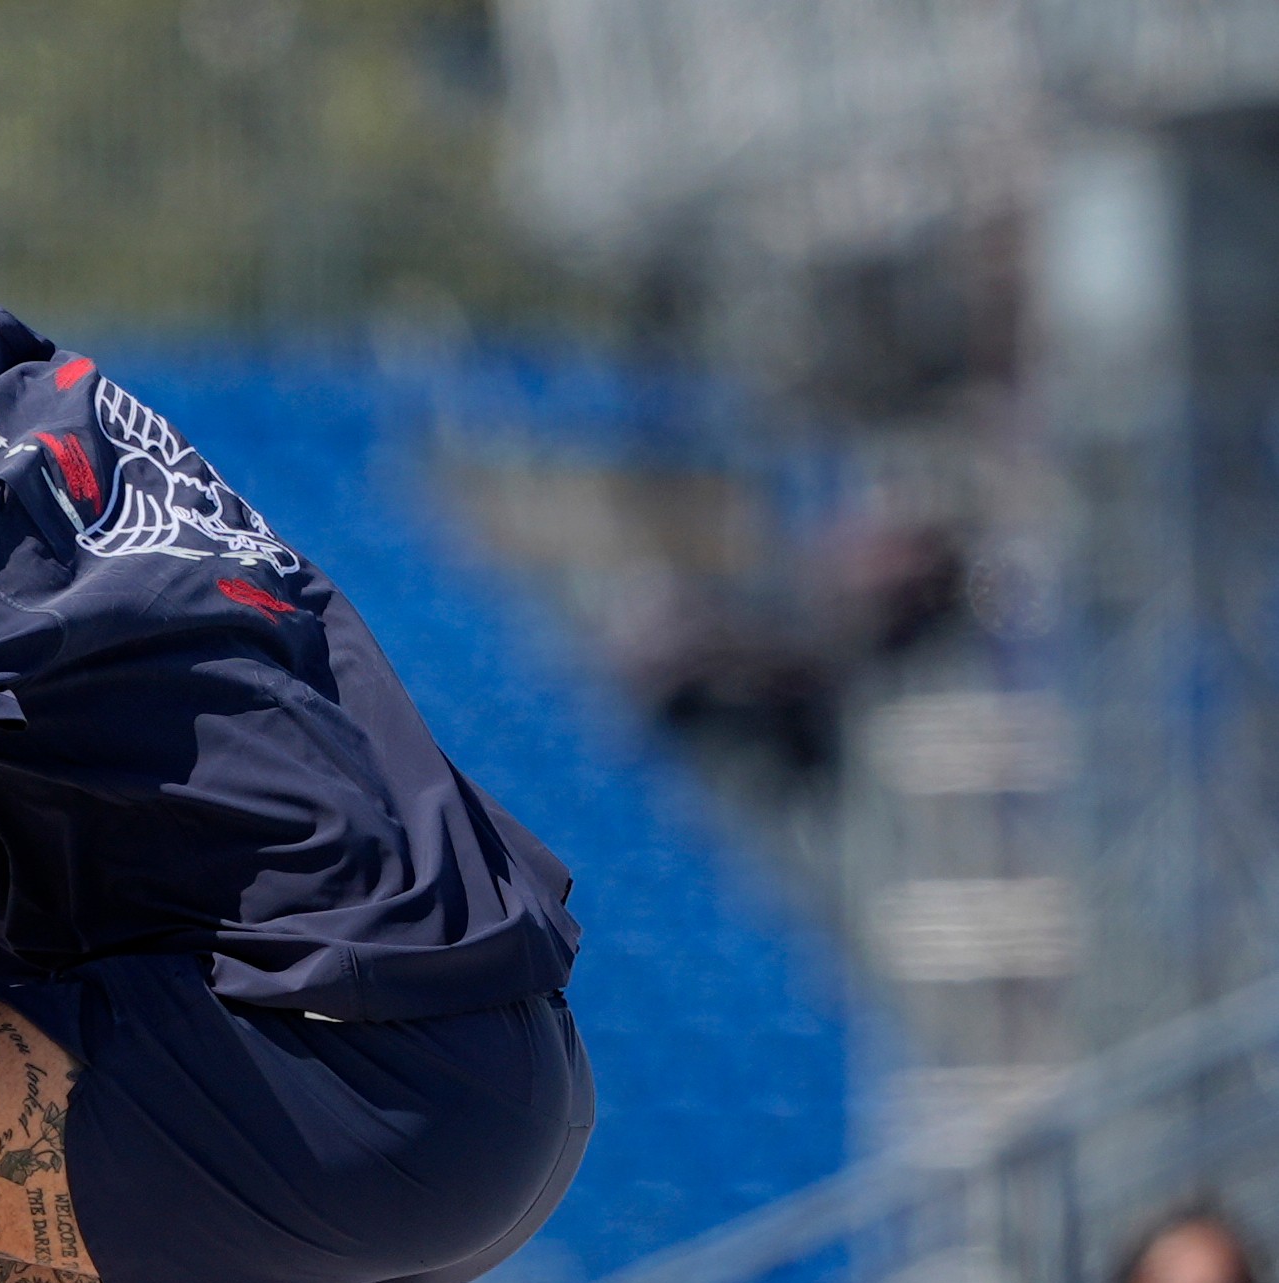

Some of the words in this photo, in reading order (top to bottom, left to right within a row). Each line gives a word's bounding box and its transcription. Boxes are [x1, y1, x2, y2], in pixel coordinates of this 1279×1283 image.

[18, 1061, 47, 1138] looked
[26, 1188, 46, 1215] THE
[54, 1193, 78, 1258] WELCOME
